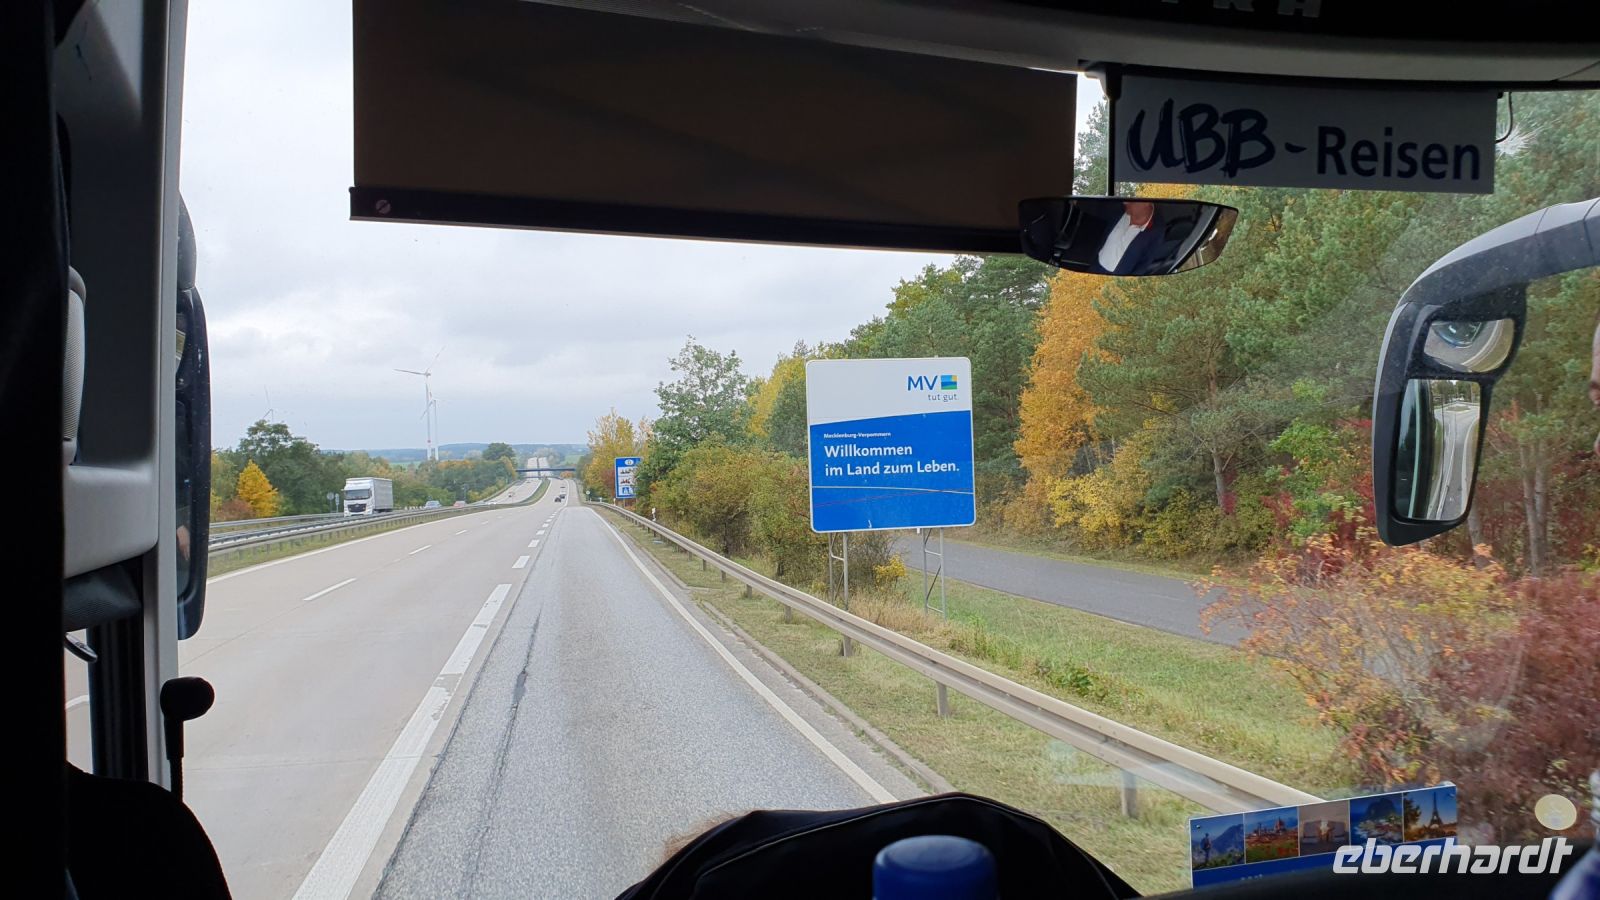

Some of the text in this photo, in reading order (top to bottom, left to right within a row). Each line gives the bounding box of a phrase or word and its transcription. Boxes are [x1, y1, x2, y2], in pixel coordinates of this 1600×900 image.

[907, 375, 938, 391] MV
[824, 444, 912, 458] Willkommen
[825, 460, 960, 476] im Land zum Leben.
